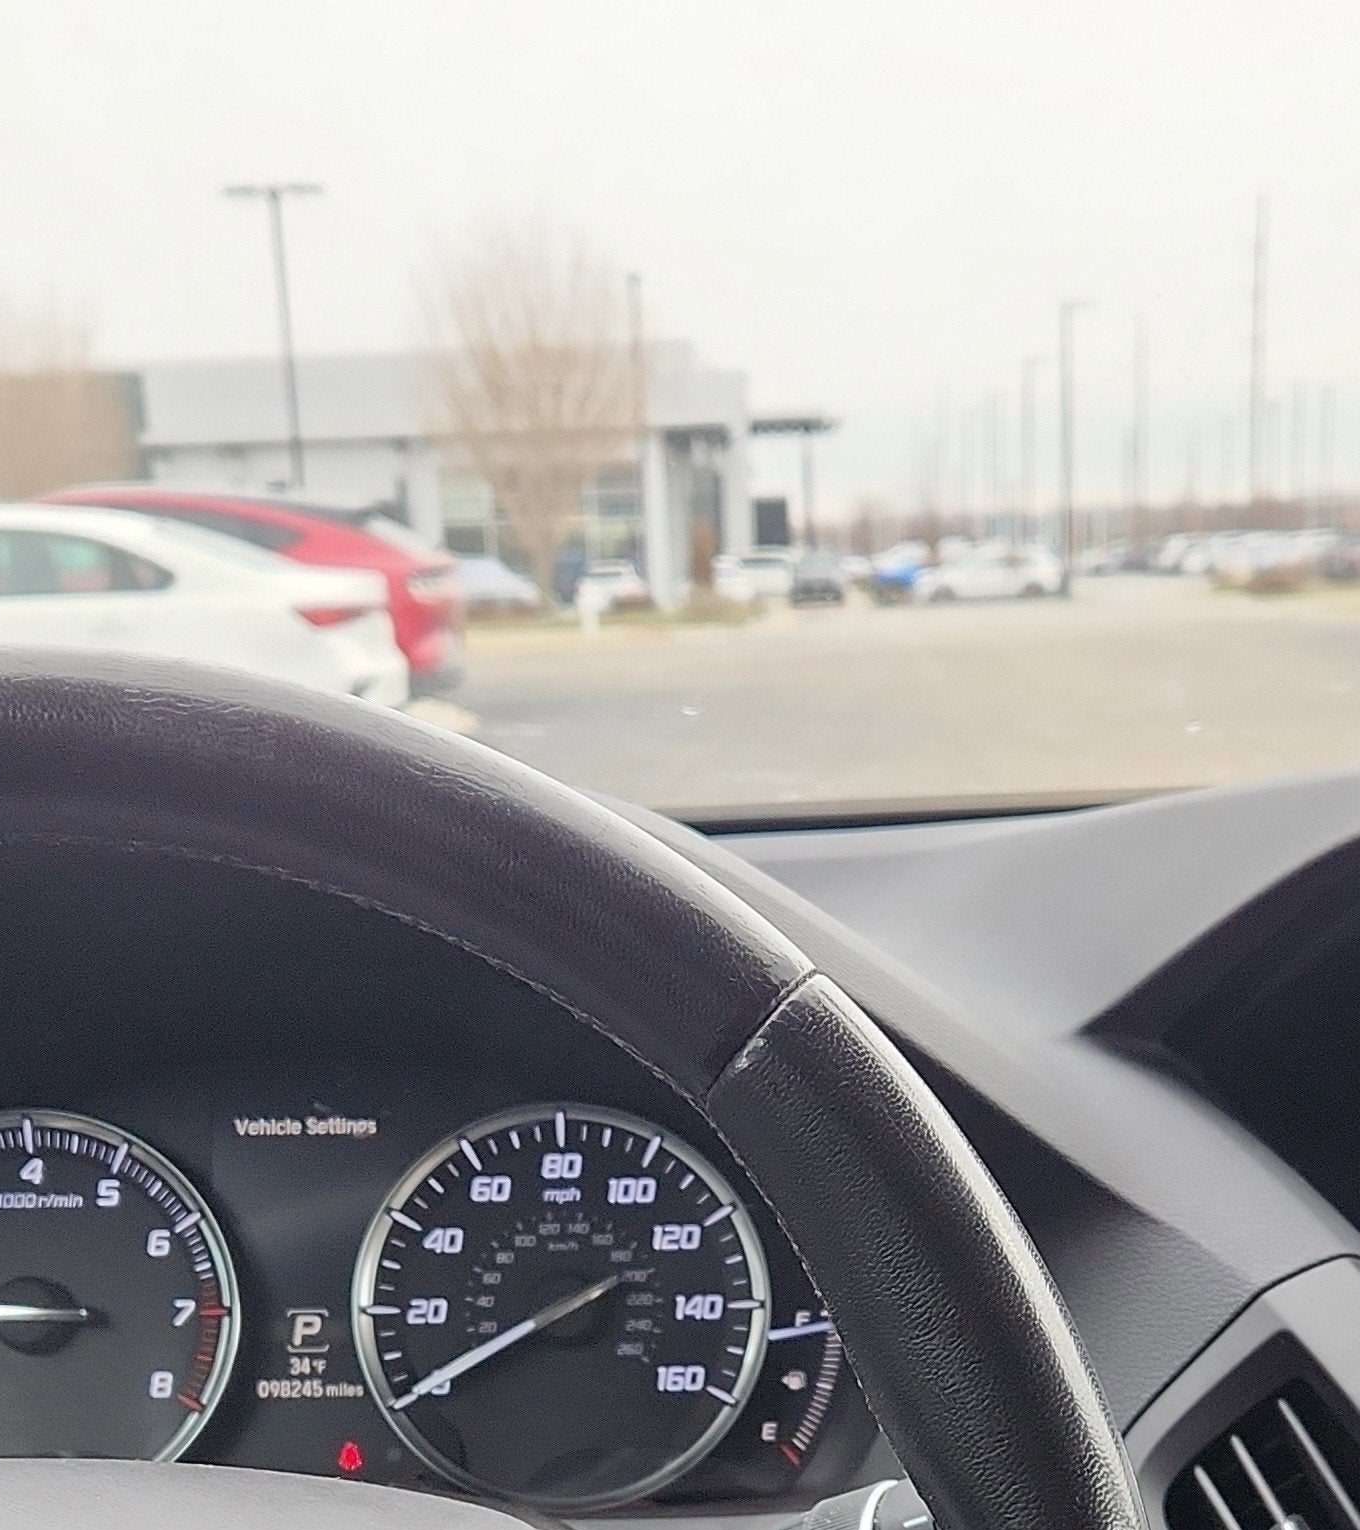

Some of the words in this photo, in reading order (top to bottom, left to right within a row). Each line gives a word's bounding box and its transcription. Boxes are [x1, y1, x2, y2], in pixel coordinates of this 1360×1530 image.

[234, 1116, 302, 1136] Vehicle
[304, 1115, 378, 1139] Settings
[20, 1157, 43, 1185] 4
[541, 1152, 582, 1180] 80
[96, 1178, 120, 1207] 5
[469, 1174, 512, 1203] 60
[542, 1184, 582, 1204] mph
[606, 1177, 657, 1205] 100
[146, 1230, 171, 1257] 6
[422, 1226, 464, 1255] 40
[652, 1224, 701, 1251] 120
[173, 1299, 197, 1327] 7
[406, 1298, 447, 1325] 20
[675, 1294, 724, 1322] 140
[292, 1314, 323, 1347] P
[149, 1370, 174, 1398] 8
[257, 1379, 324, 1399] 098245
[325, 1382, 364, 1397] miles
[656, 1365, 706, 1393] 160
[761, 1421, 778, 1442] E
